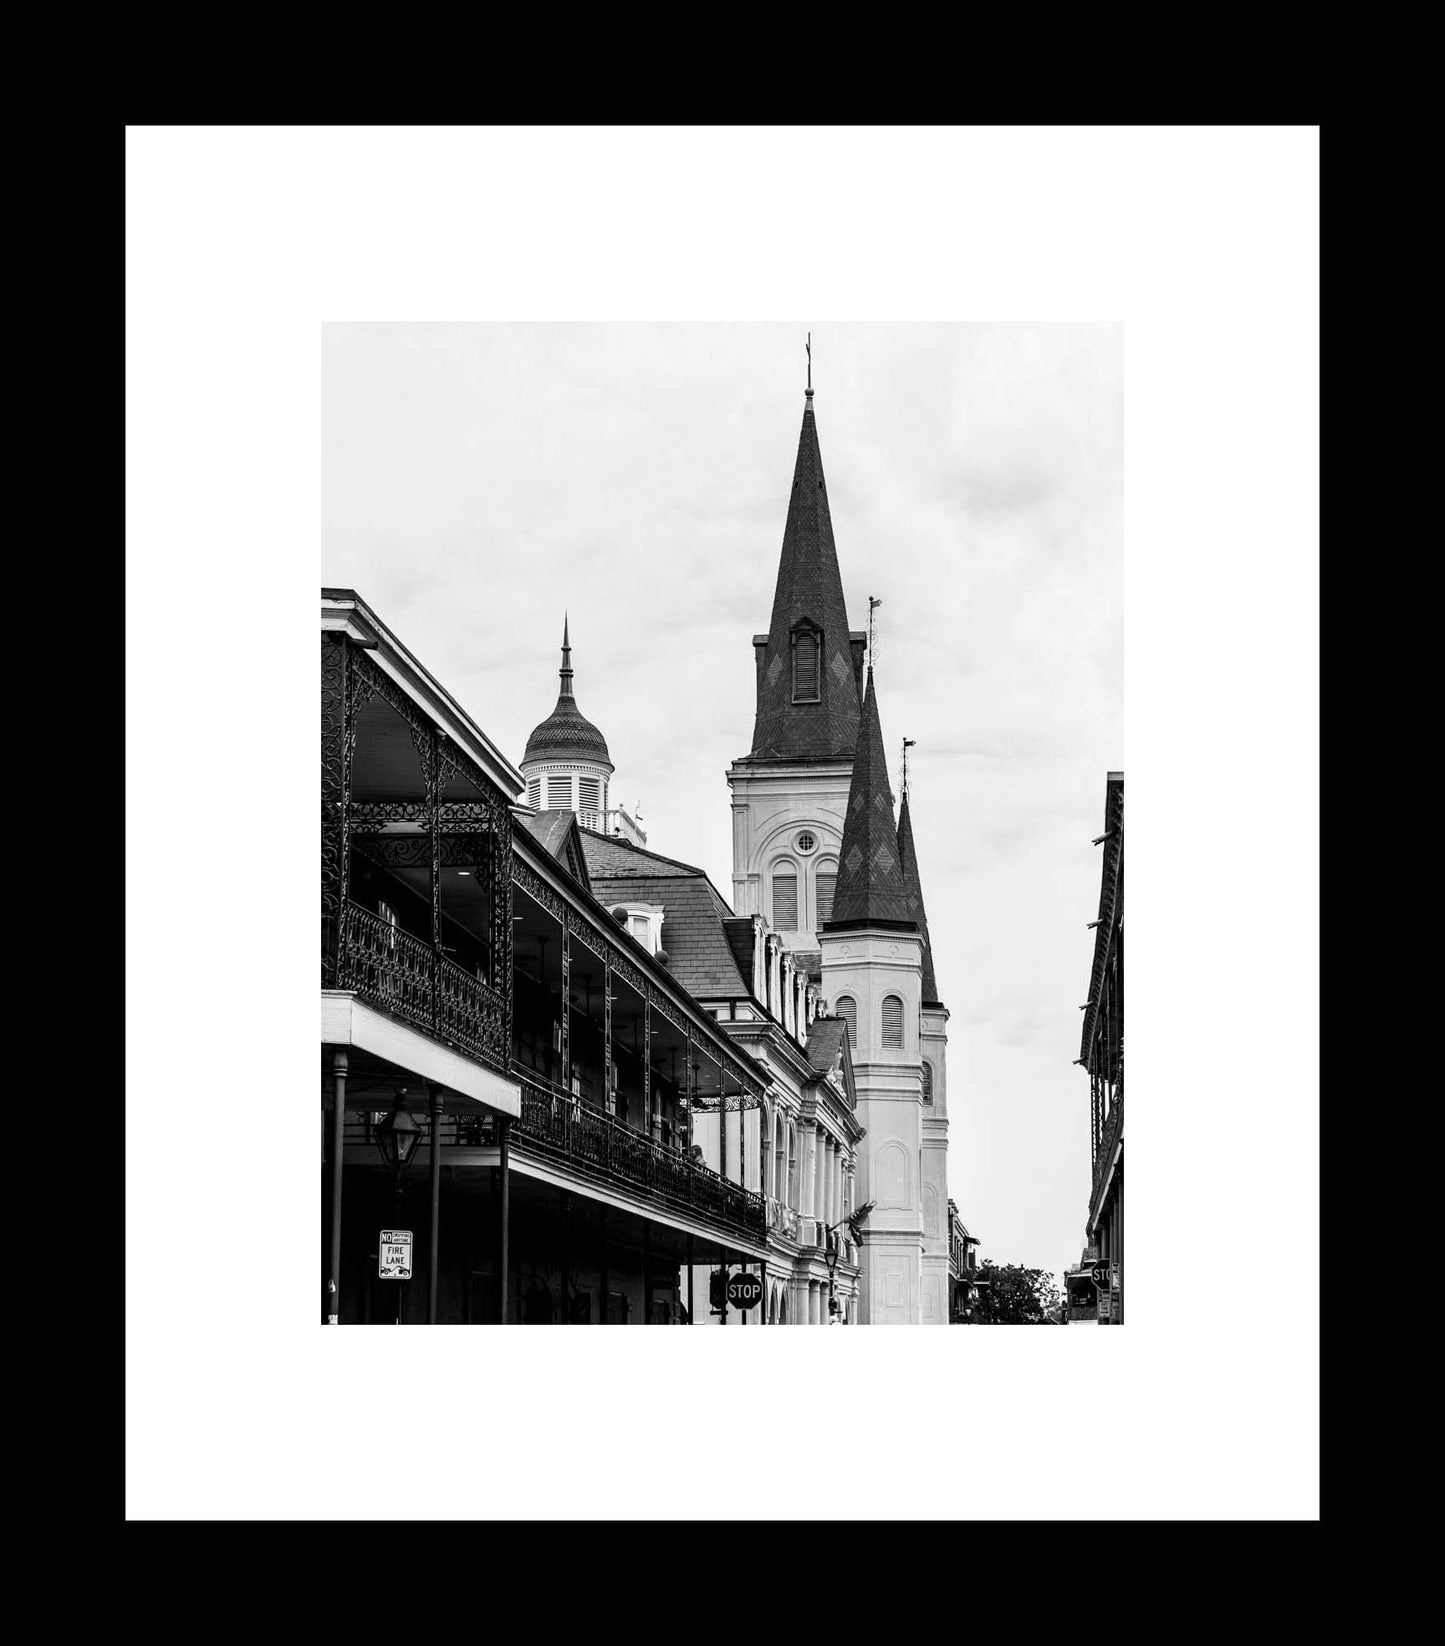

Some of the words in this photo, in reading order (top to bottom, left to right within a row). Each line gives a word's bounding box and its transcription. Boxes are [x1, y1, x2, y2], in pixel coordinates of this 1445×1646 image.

[382, 1232, 392, 1243] NO
[388, 1246, 404, 1255] FIRE
[386, 1256, 405, 1265] LANE
[1093, 1268, 1110, 1281] STO
[729, 1284, 760, 1298] STOP
